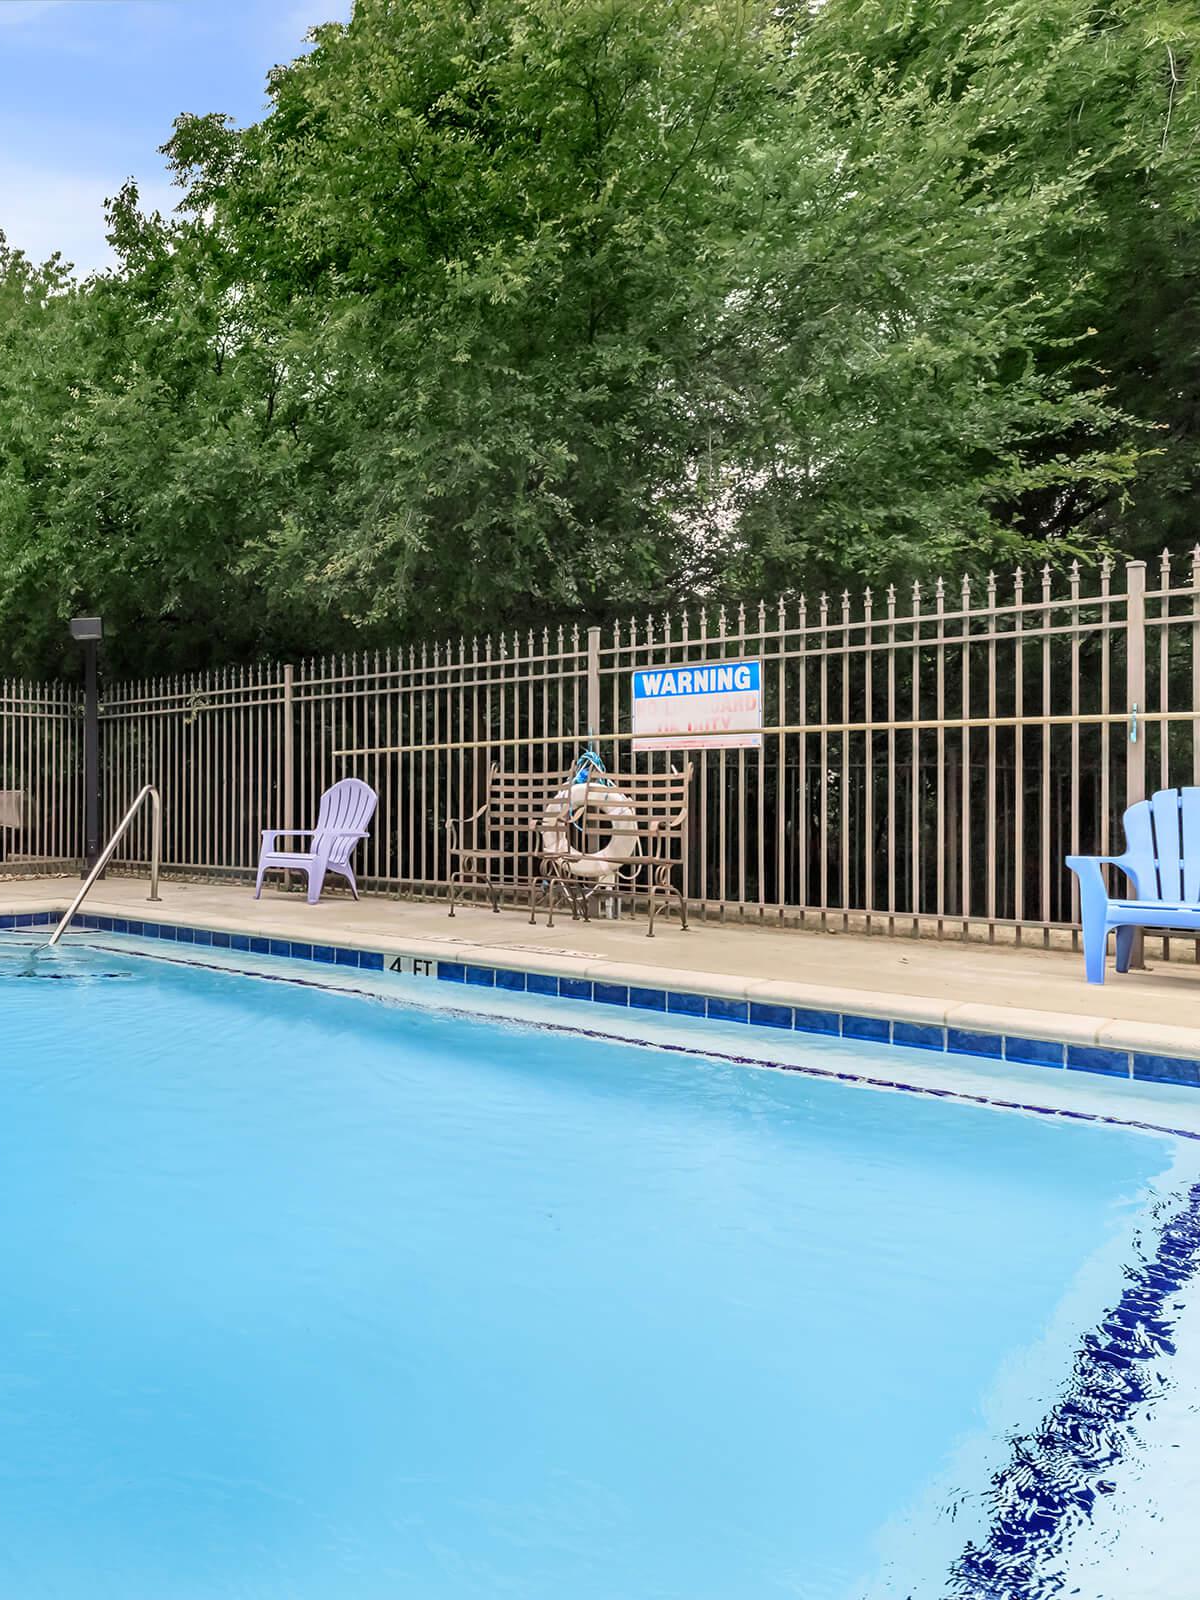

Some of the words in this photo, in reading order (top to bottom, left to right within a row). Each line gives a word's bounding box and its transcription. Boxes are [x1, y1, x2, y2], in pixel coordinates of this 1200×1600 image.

[642, 665, 751, 696] WARNING
[389, 957, 401, 973] 4
[413, 959, 432, 976] FT
